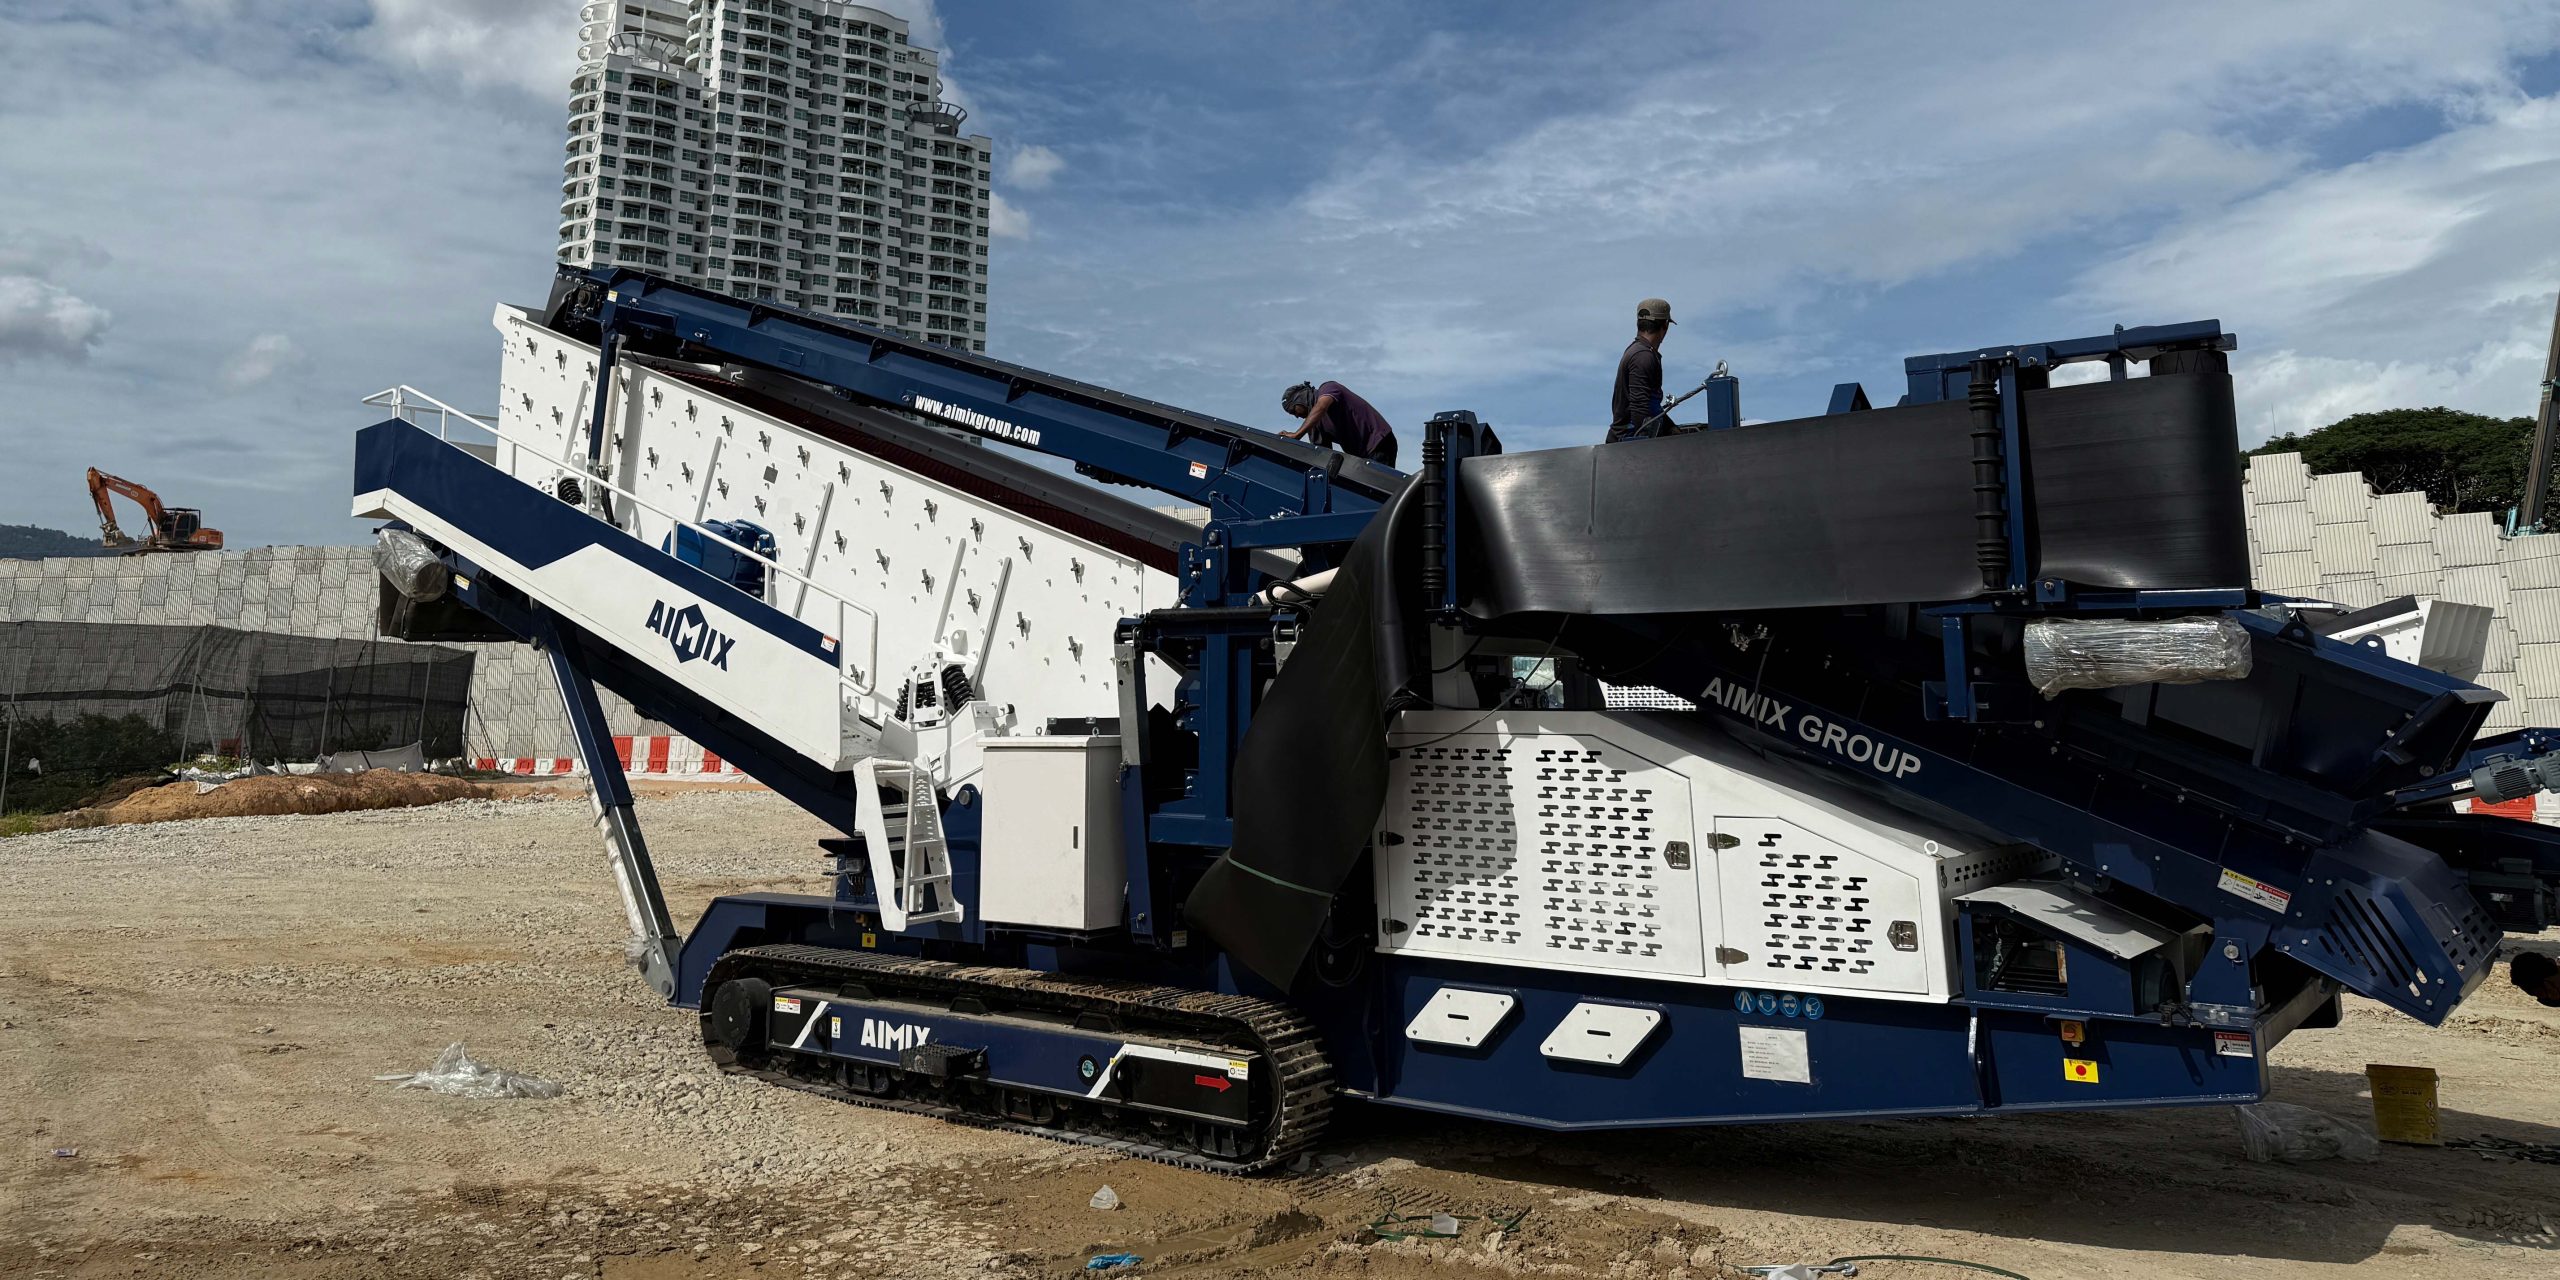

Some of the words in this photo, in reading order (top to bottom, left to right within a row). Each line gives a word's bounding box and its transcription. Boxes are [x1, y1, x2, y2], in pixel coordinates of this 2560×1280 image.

[914, 394, 1041, 446] www.aimixgroup.com
[645, 599, 736, 672] AIMIX
[1700, 677, 1792, 731] AIMIX
[1798, 714, 1921, 779] GROUP
[860, 1018, 931, 1051] AIMIX
